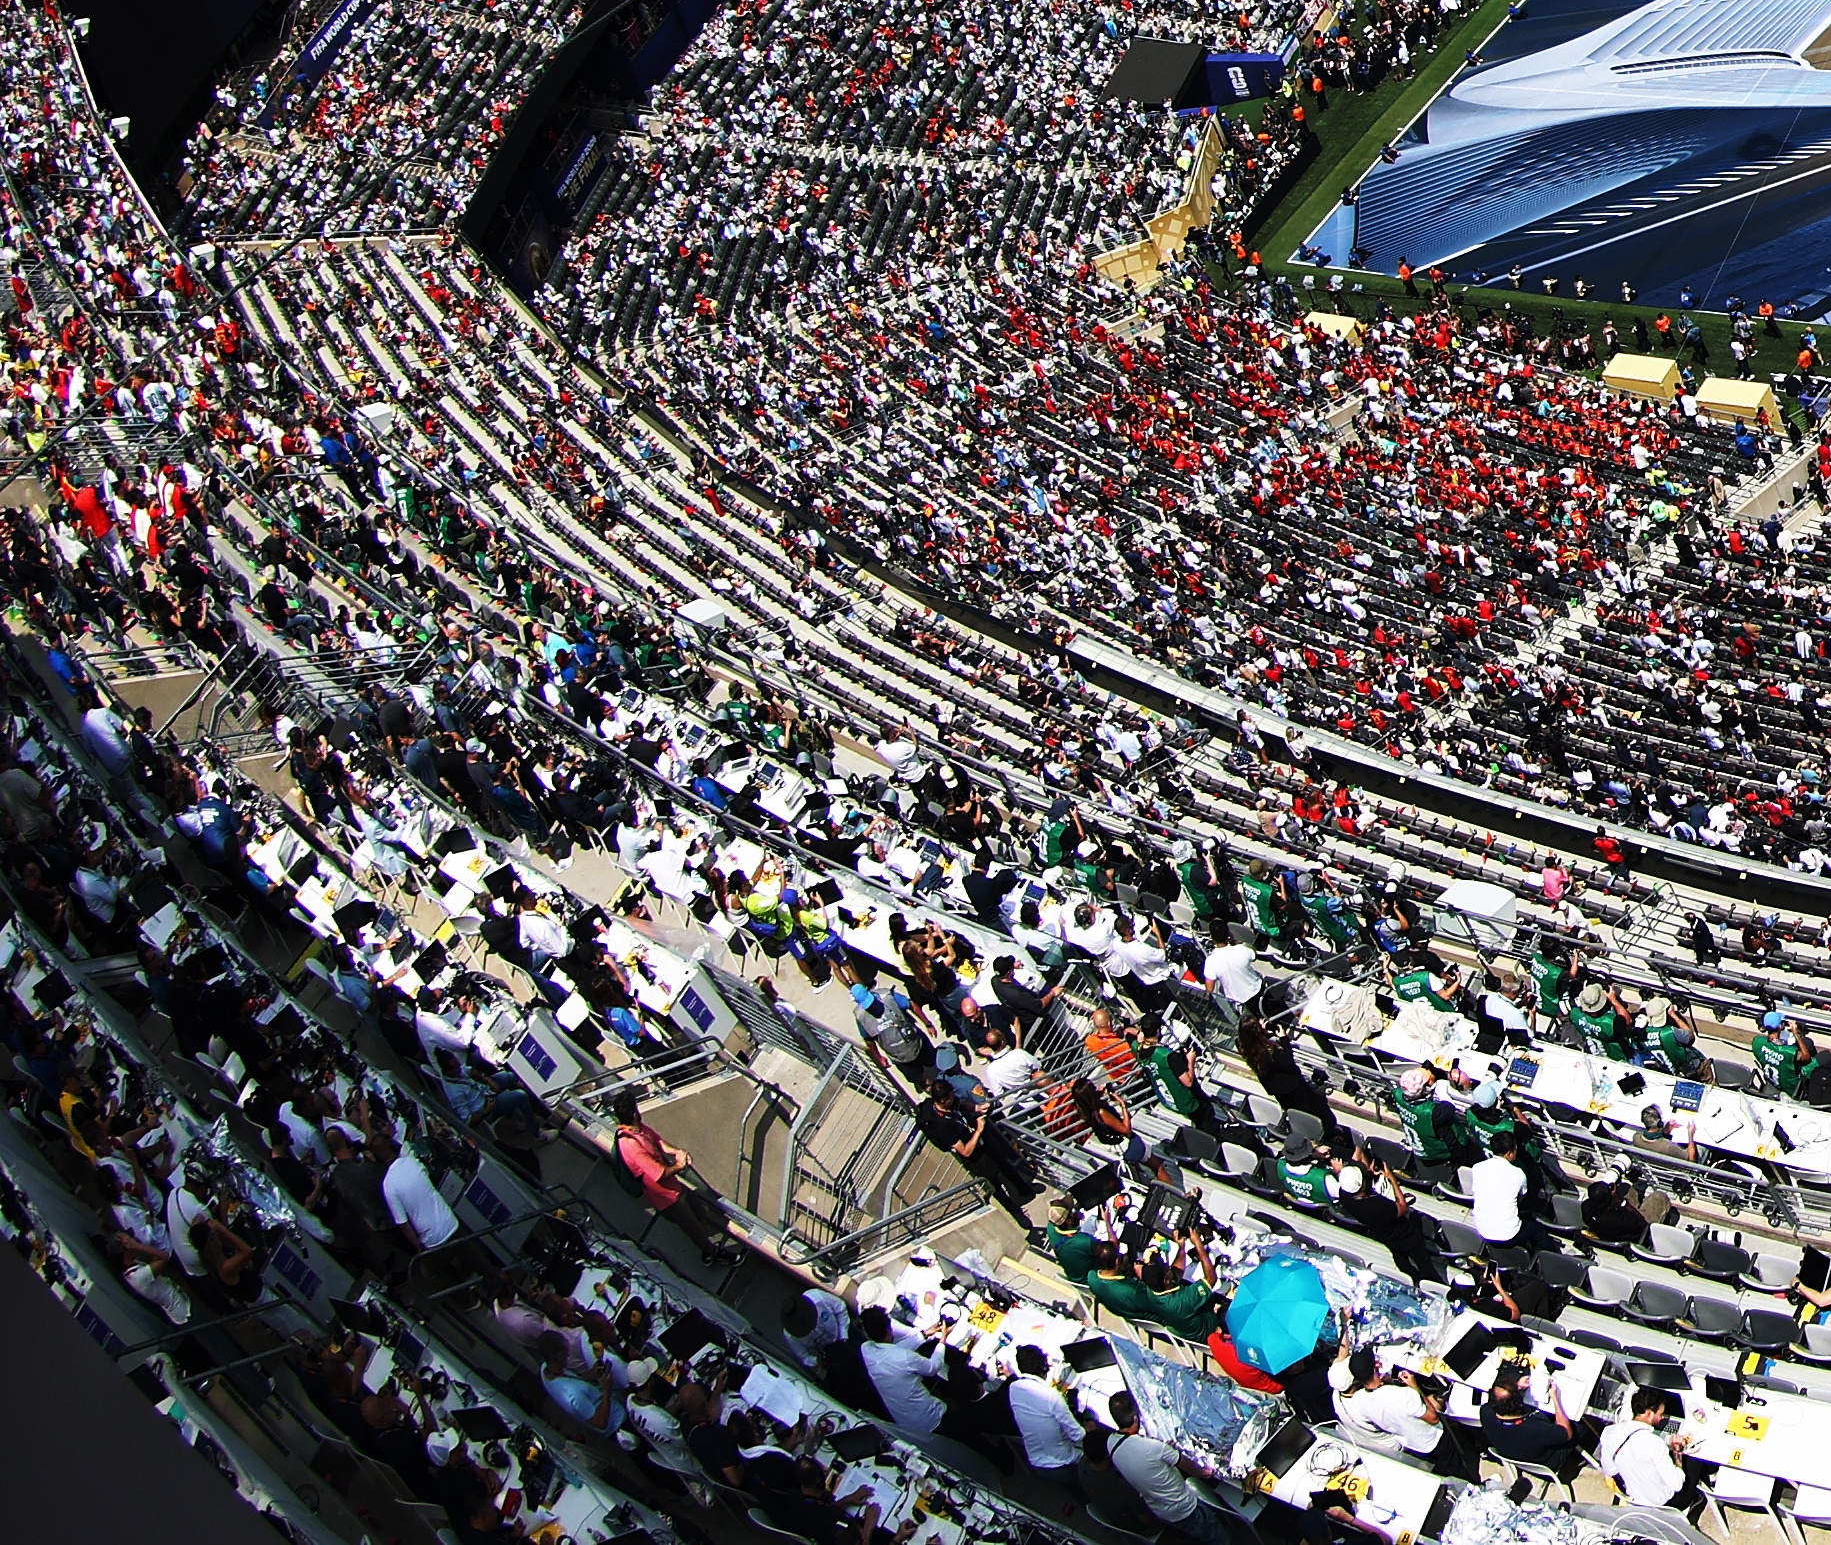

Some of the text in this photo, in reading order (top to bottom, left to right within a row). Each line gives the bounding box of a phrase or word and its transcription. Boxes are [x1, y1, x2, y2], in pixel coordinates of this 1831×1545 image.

[310, 34, 329, 61] FIFA
[328, 7, 351, 41] WORLD
[1398, 981, 1424, 991] PHOTO
[977, 1310, 998, 1325] 48
[1337, 1475, 1361, 1492] 46
